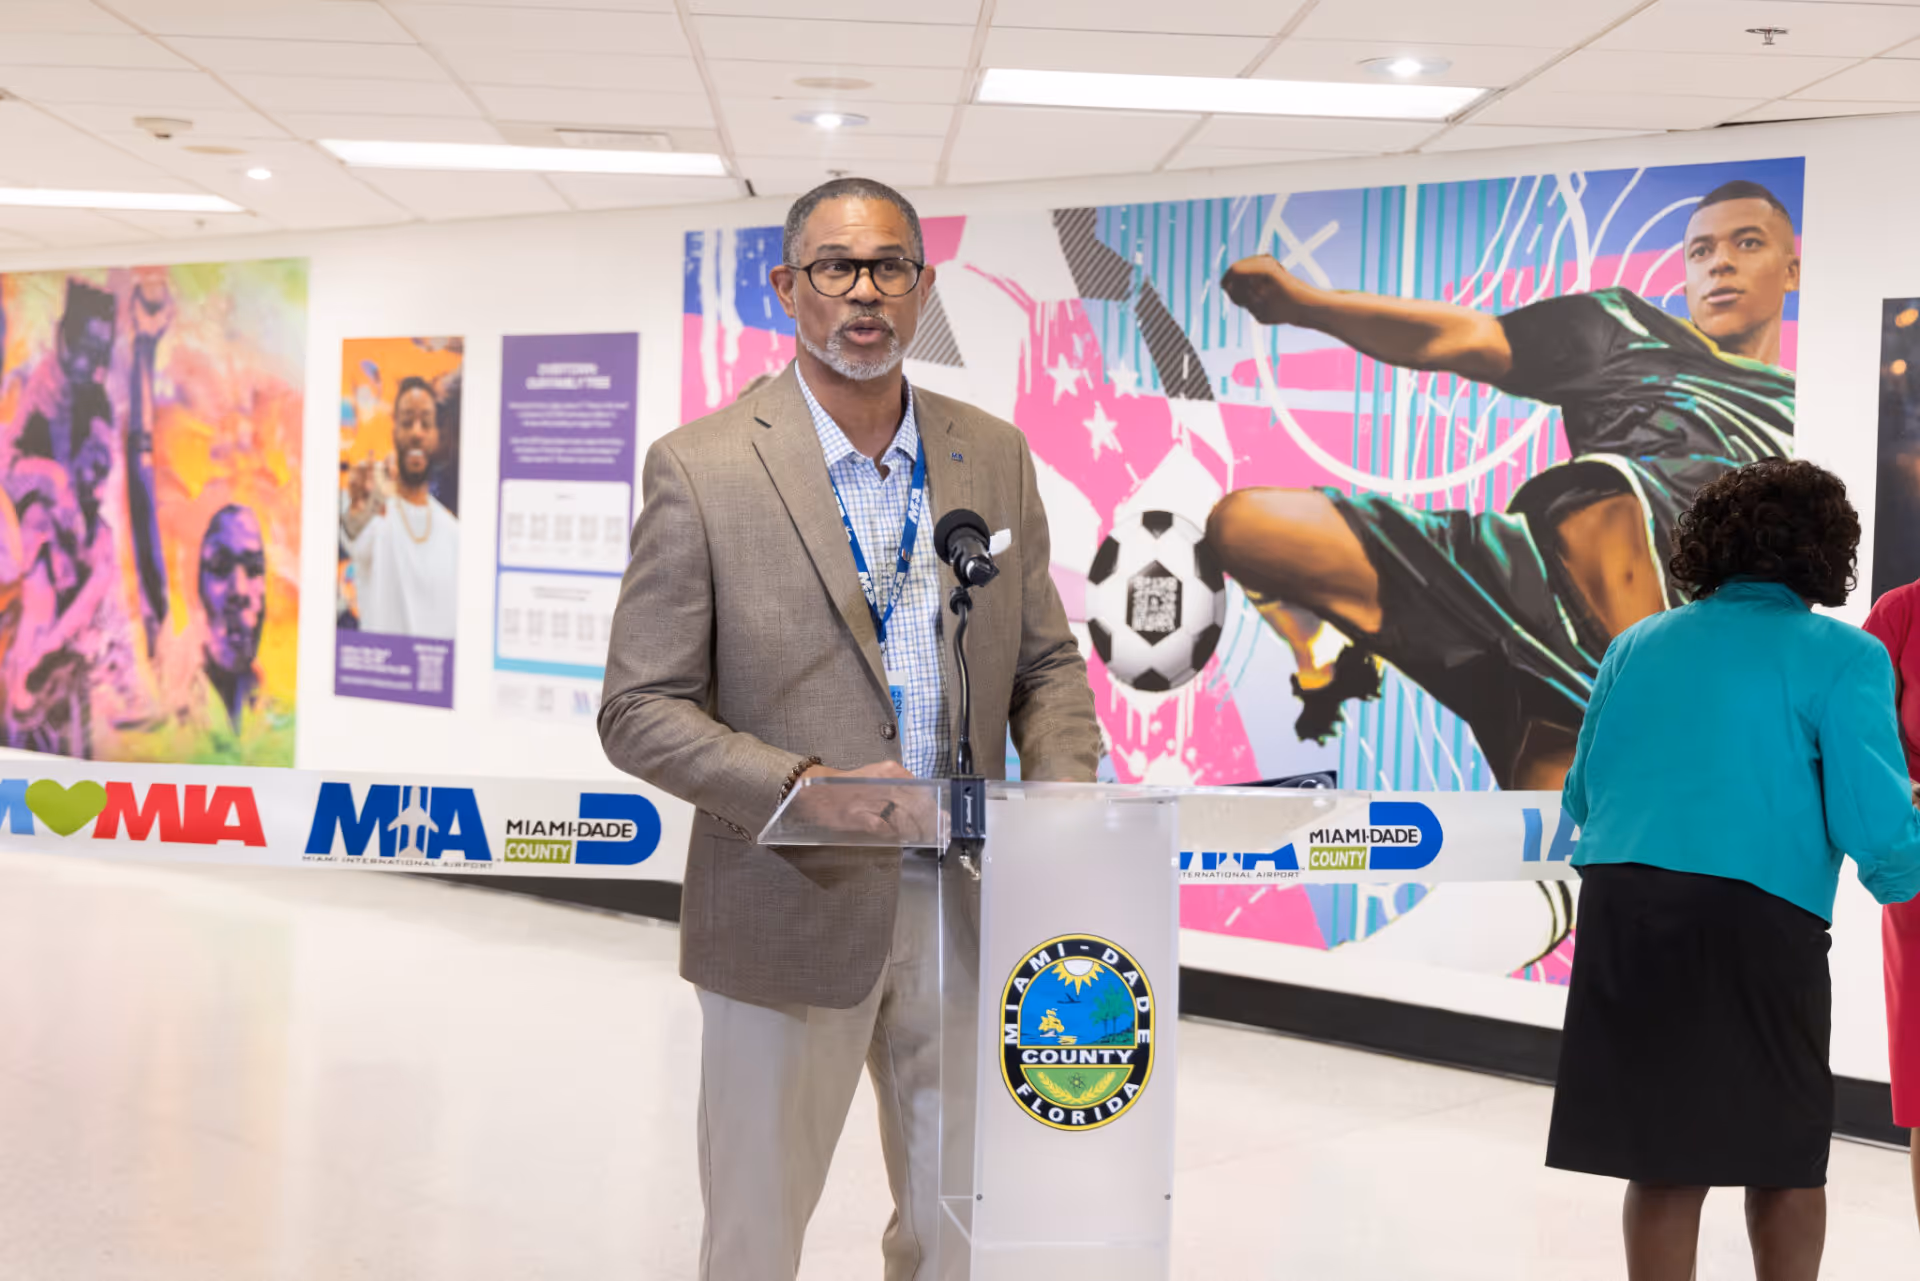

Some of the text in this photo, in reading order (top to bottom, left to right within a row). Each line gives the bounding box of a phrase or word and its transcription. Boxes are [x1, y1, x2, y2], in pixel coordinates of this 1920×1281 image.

[92, 781, 267, 847] MIA
[304, 782, 493, 861] MIA
[507, 842, 570, 861] COUNTY
[1310, 850, 1366, 867] COUNTY
[302, 855, 494, 870] MIAMI INTERNATIONAL AIRPORT
[1179, 871, 1300, 879] TERNATIONAL AIRPORT
[1021, 1049, 1134, 1064] COUNTY
[1016, 1082, 1140, 1125] FLORIDA
